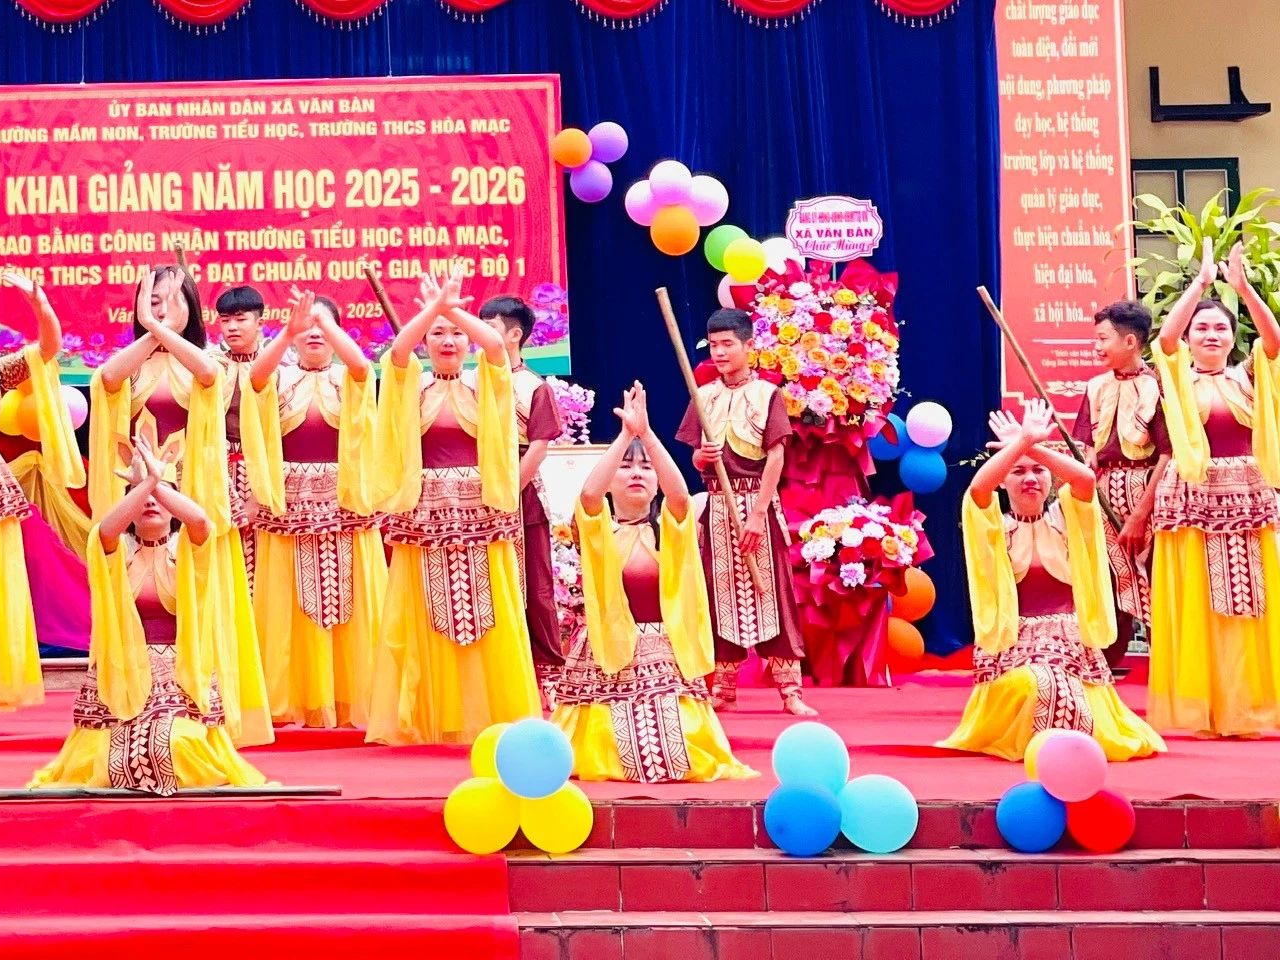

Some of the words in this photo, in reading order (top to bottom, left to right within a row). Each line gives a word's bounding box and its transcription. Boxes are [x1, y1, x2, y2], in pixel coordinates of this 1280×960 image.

[1028, 0, 1058, 26] lượng
[1012, 36, 1034, 58] toàn
[1035, 35, 1061, 64] diện,
[1061, 29, 1078, 58] đổi
[1079, 35, 1099, 58] mới
[1017, 73, 1046, 101] dung,
[1046, 73, 1086, 101] phương
[1086, 72, 1113, 101] pháp
[108, 100, 131, 118] ỦY
[135, 101, 171, 118] BAN
[176, 99, 226, 117] NHÂN
[230, 98, 266, 116] DÂN
[271, 98, 294, 115] XÃ
[299, 97, 334, 115] VĂN
[339, 97, 376, 113] BÀN
[1015, 111, 1033, 139] dạy
[1035, 111, 1056, 139] học,
[1057, 111, 1070, 139] hệ
[1071, 105, 1100, 139] thống
[102, 125, 144, 142] NON,
[149, 122, 218, 140] TRƯỜNG
[222, 119, 260, 139] TIỂU
[264, 123, 305, 141] HỌC,
[309, 120, 378, 137] TRƯỜNG
[382, 119, 426, 135] THCS
[431, 116, 467, 135] HÒA
[471, 118, 511, 137] MẠC
[1003, 148, 1039, 177] trường
[1039, 148, 1056, 177] lớp
[1057, 148, 1070, 170] và
[1071, 148, 1084, 177] hệ
[1085, 142, 1115, 177] thống
[6, 174, 78, 216] KHAI
[88, 160, 183, 214] GIẢNG
[192, 163, 264, 212] NĂM
[274, 168, 336, 219] HỌC
[345, 167, 421, 208] 2025
[429, 184, 442, 194] -
[451, 165, 527, 206] 2026
[1021, 187, 1046, 215] quản
[1059, 187, 1080, 215] giáo
[1081, 187, 1103, 214] dục,
[38, 226, 95, 255] BẰNG
[100, 228, 156, 254] CÔNG
[162, 227, 220, 256] NHẬN
[224, 226, 306, 252] TRƯỜNG
[311, 220, 356, 249] TIỂU
[361, 226, 403, 252] HỌC
[408, 221, 451, 248] HÒA
[456, 224, 510, 250] MẠC,
[1013, 225, 1036, 252] thực
[1037, 225, 1059, 252] hiện
[1061, 219, 1091, 248] chuẩn
[1091, 225, 1115, 250] hóa,
[50, 264, 102, 287] THCS
[207, 262, 246, 286] ĐẠT
[252, 254, 322, 283] CHUẨN
[389, 258, 422, 279] GIA
[481, 253, 510, 282] ĐỘ
[516, 257, 527, 277] 1
[1034, 262, 1056, 290] hiện
[1057, 262, 1074, 290] đại
[1075, 262, 1097, 288] hóa,
[347, 303, 384, 319] 2025
[1034, 301, 1046, 323] xã
[1048, 300, 1064, 328] hội
